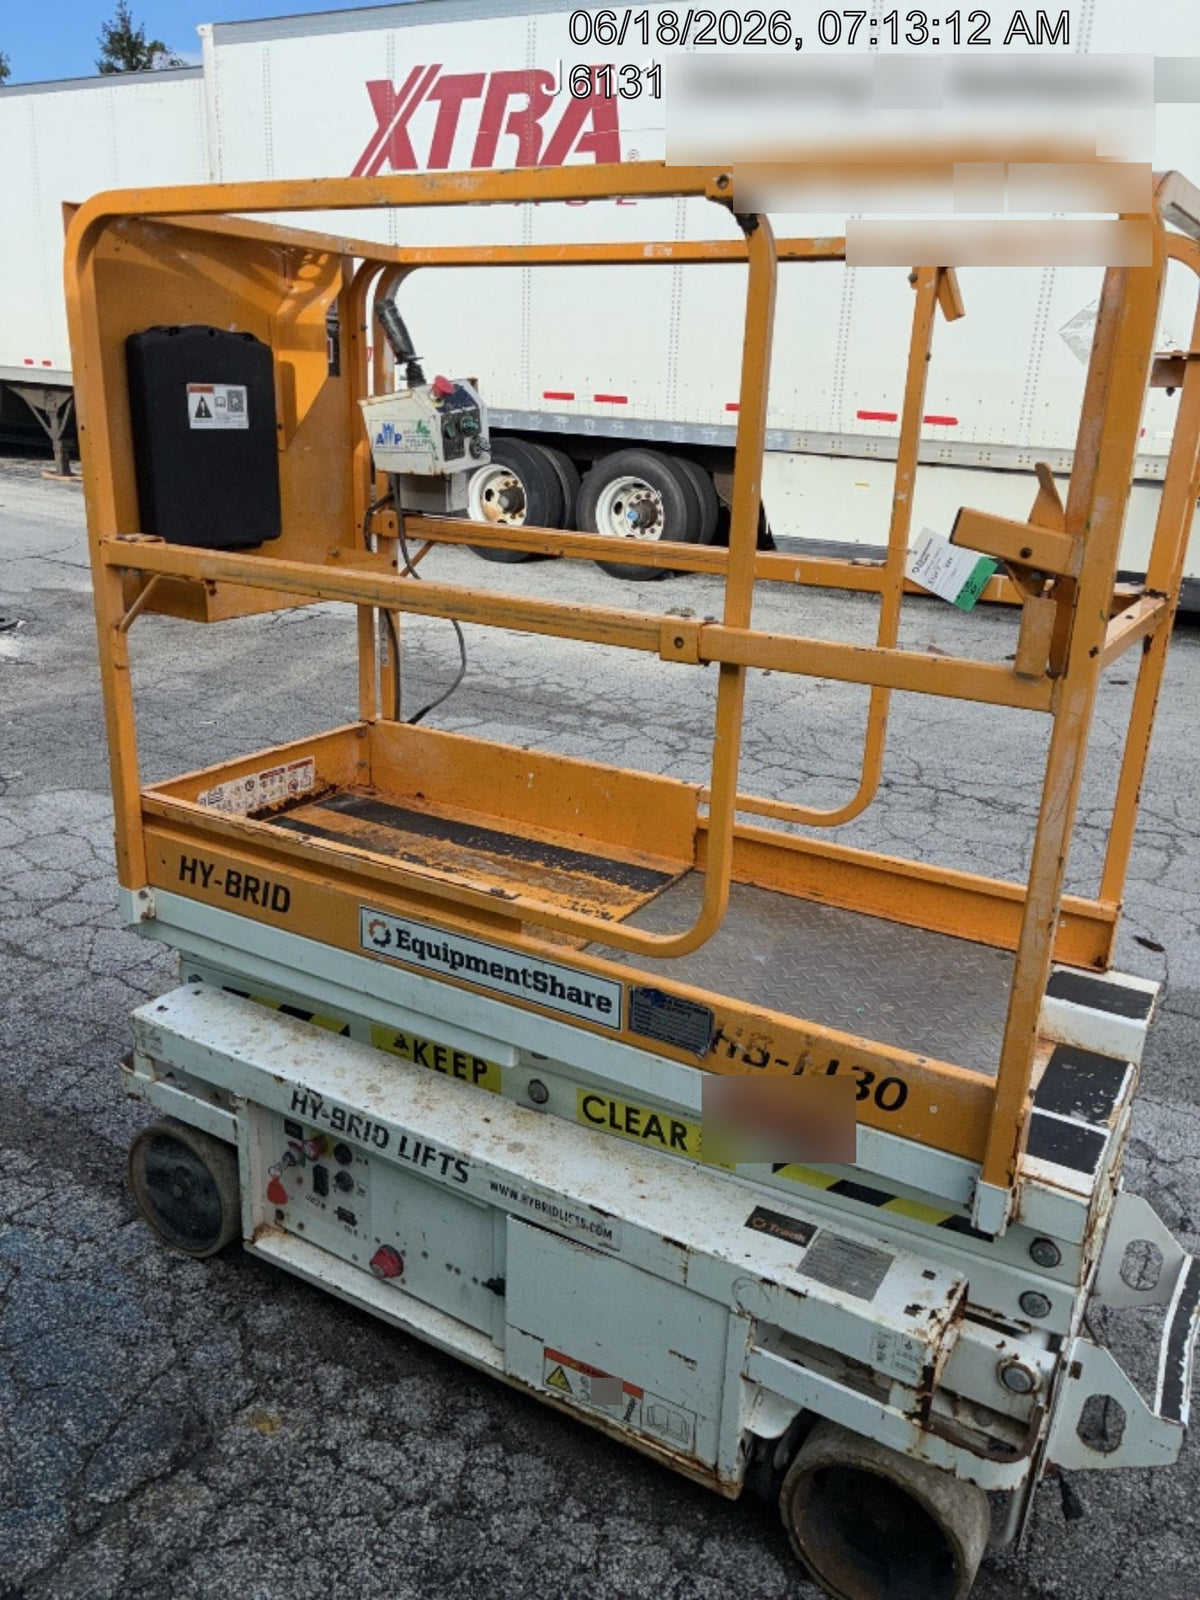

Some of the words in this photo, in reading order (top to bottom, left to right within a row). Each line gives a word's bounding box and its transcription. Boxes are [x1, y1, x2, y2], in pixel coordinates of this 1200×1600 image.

[350, 63, 622, 178] XTRA
[179, 855, 291, 914] HY-BRID
[396, 929, 613, 1014] EquipmentShare
[413, 1037, 488, 1084] KEEP
[291, 1088, 390, 1151] HY-BRID
[398, 1136, 471, 1186] LIFTS
[582, 1094, 688, 1152] CLEAR
